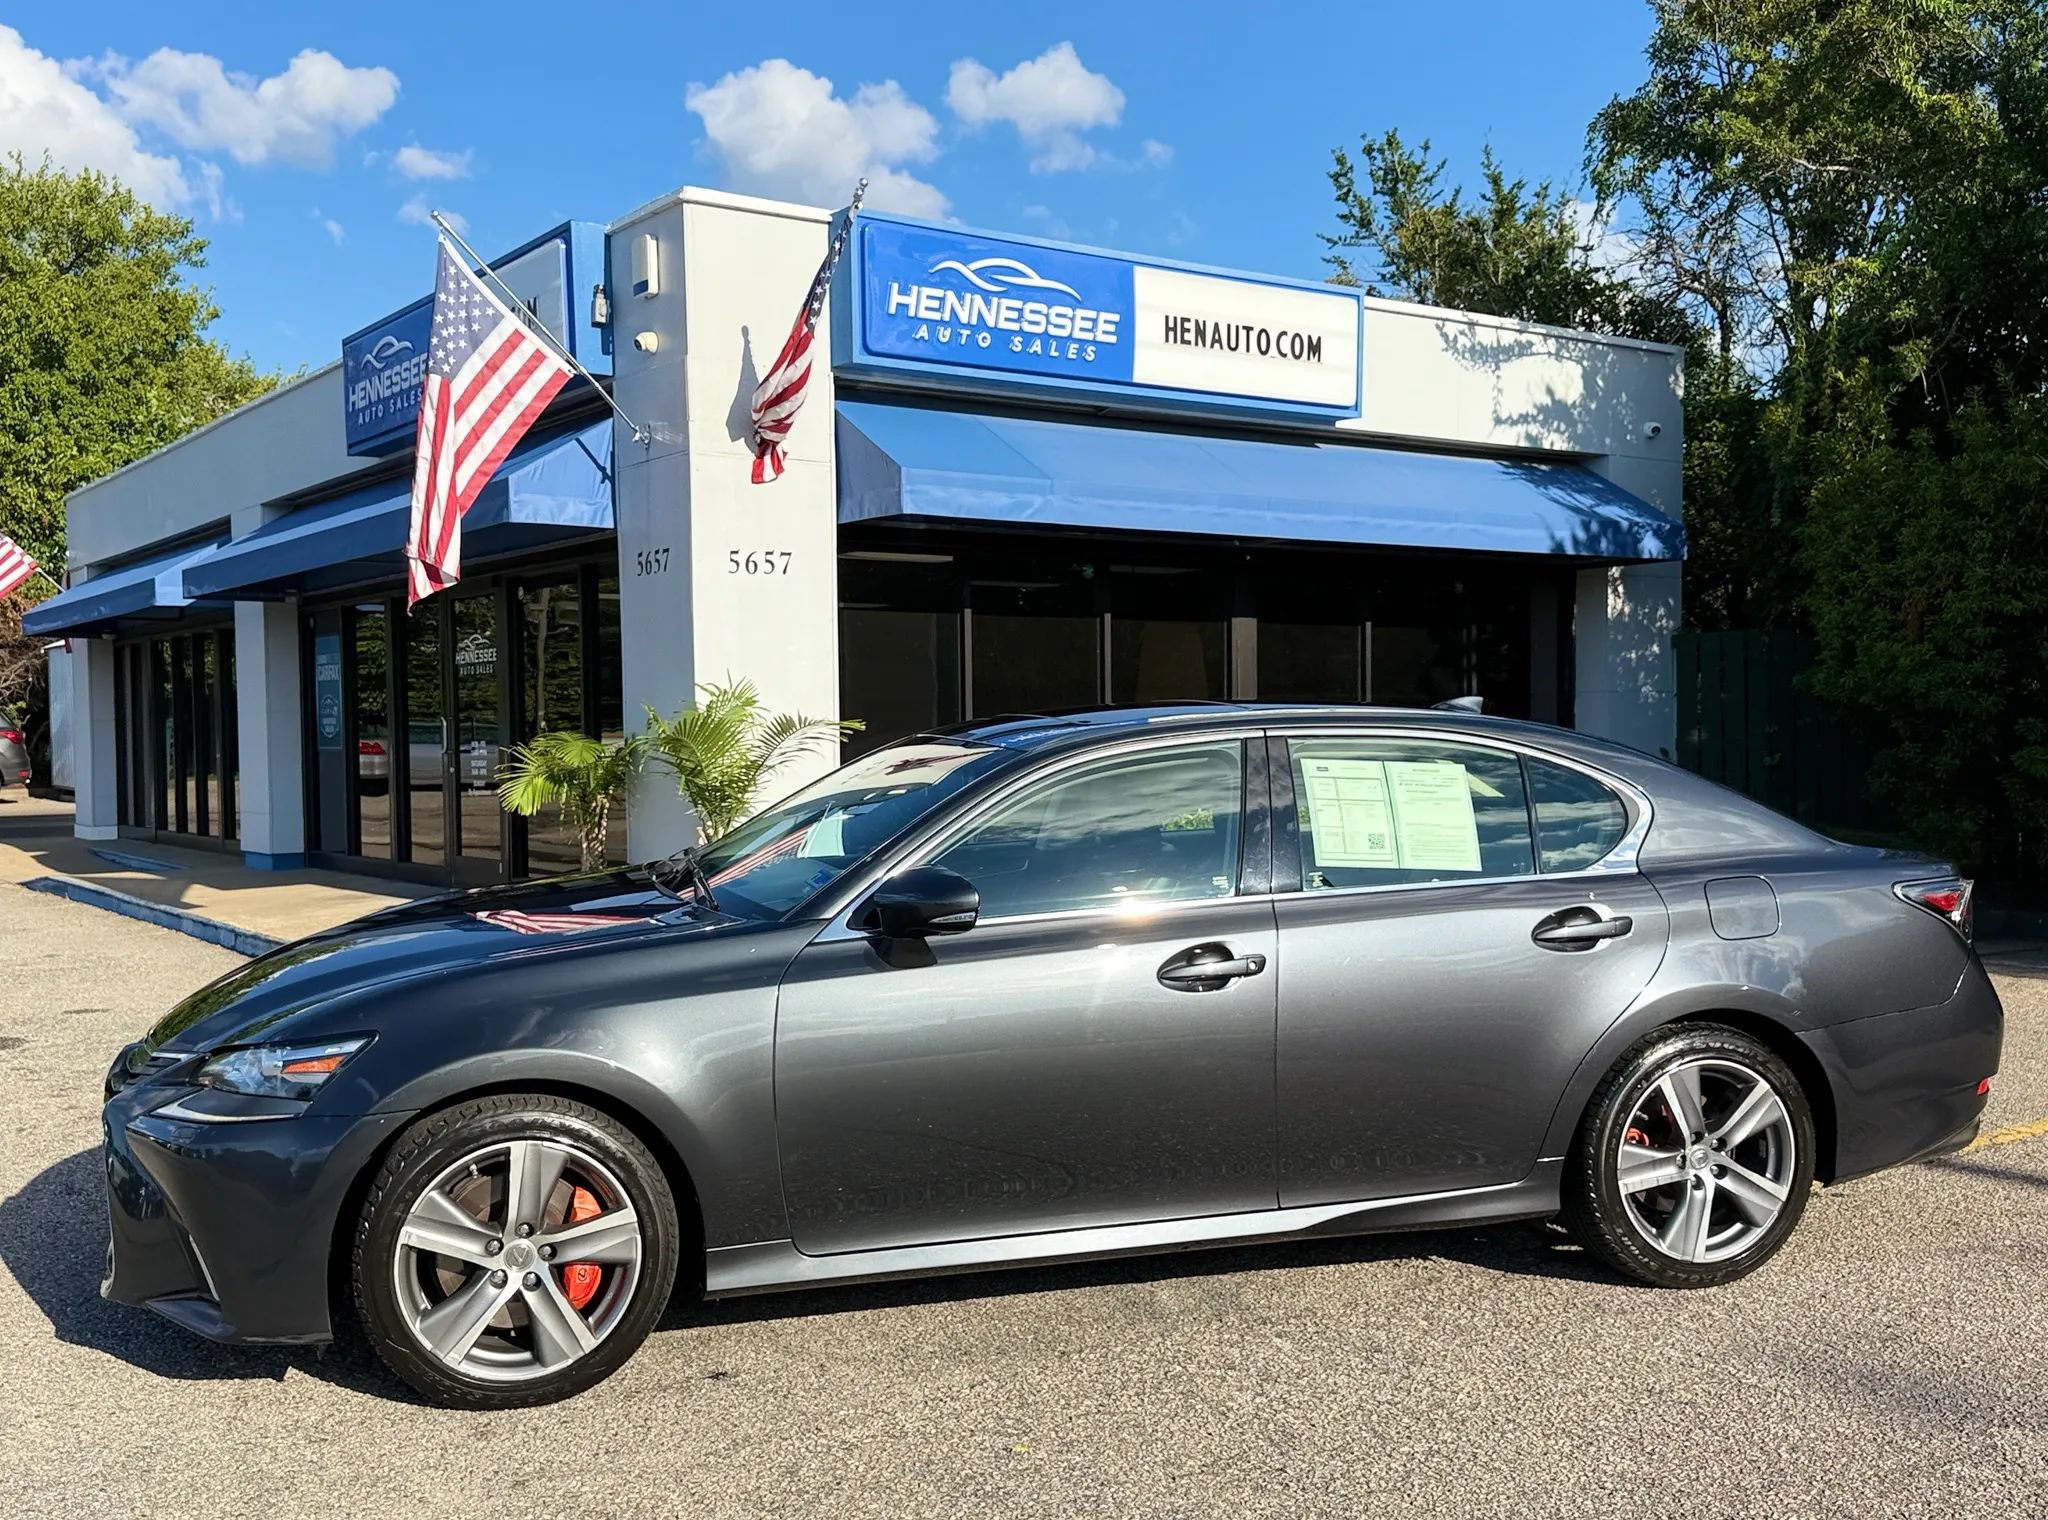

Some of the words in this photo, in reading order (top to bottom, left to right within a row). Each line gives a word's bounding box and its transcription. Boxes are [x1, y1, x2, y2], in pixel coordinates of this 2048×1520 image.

[887, 281, 1121, 344] HENNESSEE
[912, 324, 993, 348] AUTO
[1008, 336, 1098, 362] SALES
[359, 404, 384, 425] AUTO
[389, 387, 423, 413] SALES
[637, 548, 670, 576] 5657
[728, 550, 792, 575] 5657
[455, 648, 497, 665] HENNESSEE
